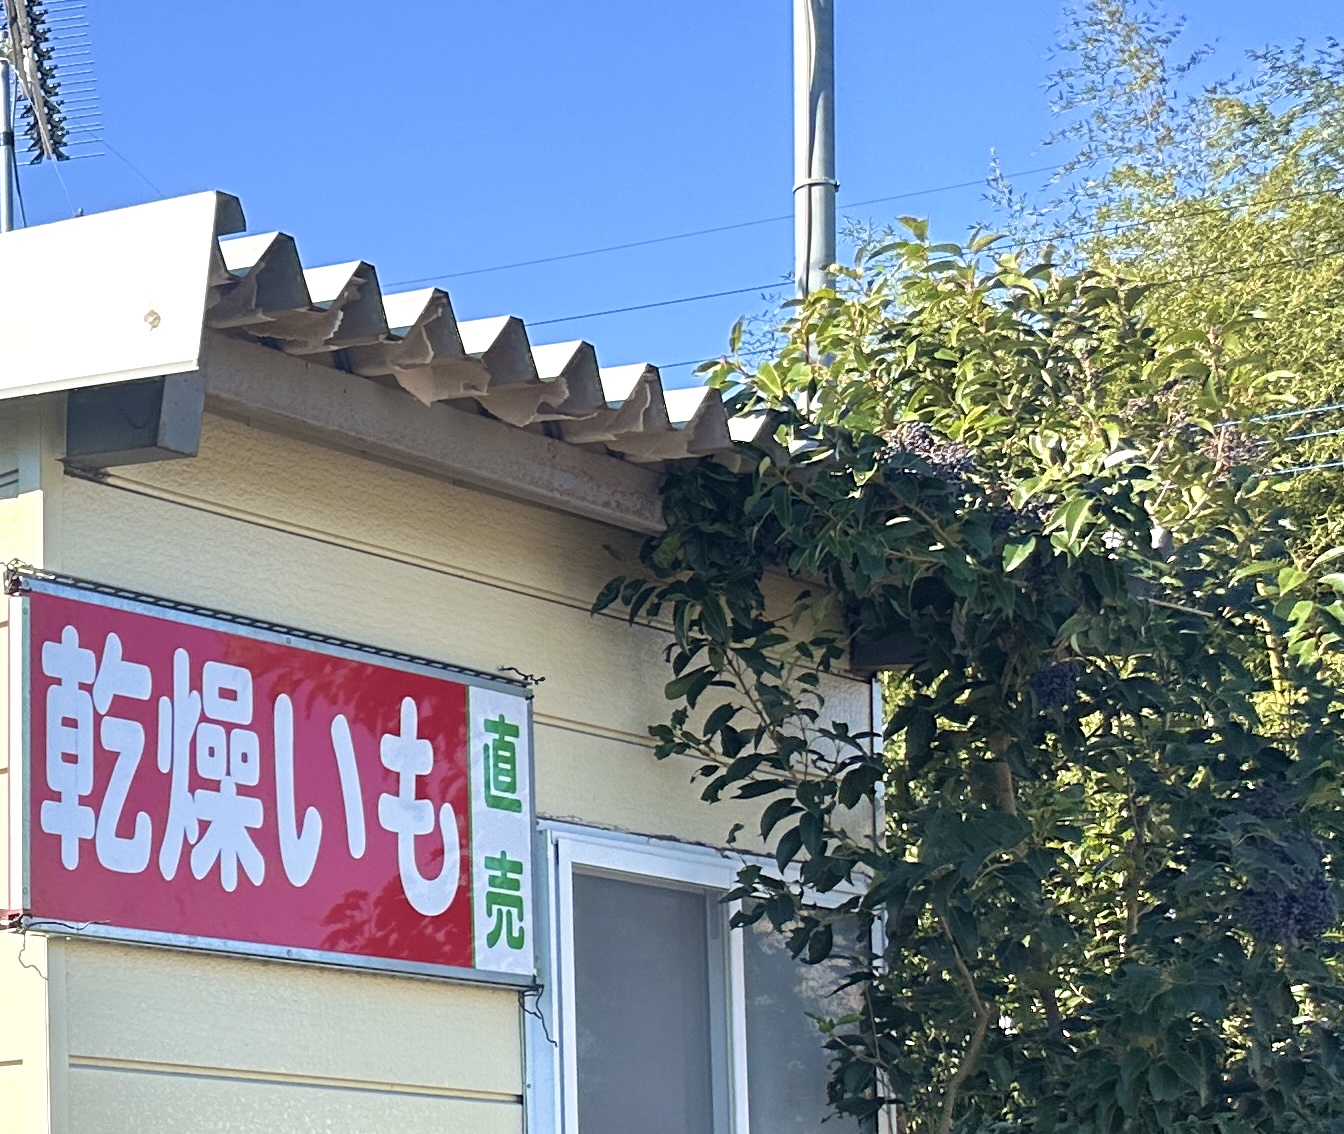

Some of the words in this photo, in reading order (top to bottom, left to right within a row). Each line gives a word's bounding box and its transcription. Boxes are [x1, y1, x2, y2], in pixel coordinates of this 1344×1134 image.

[40, 624, 461, 916] 乾燥いも
[481, 713, 525, 950] 直売
